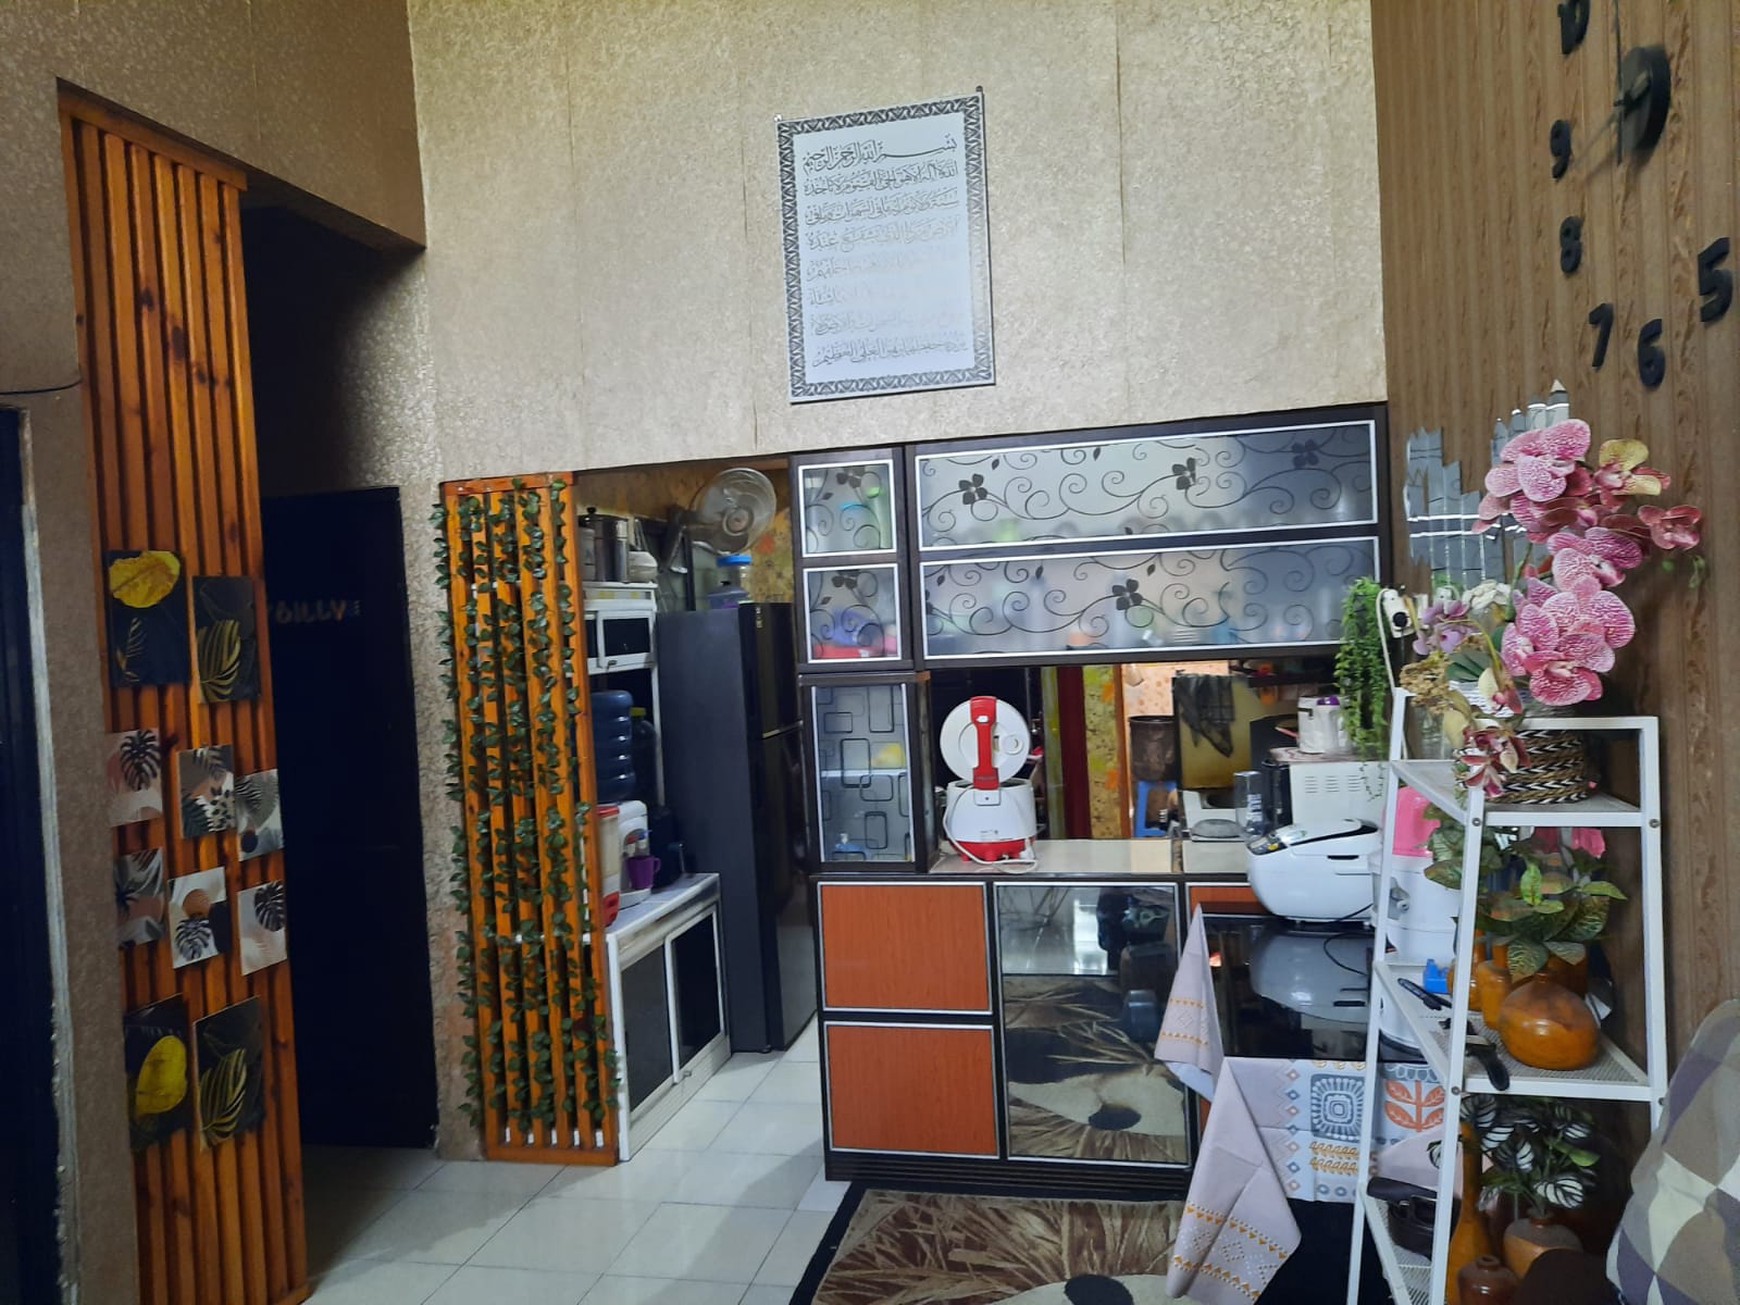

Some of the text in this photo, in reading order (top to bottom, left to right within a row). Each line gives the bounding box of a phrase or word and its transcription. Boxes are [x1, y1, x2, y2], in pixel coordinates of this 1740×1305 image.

[1550, 118, 1572, 180] 9
[1559, 214, 1582, 275] 8
[1697, 236, 1734, 324] 5
[1588, 302, 1614, 370] 7
[1637, 317, 1666, 390] 6
